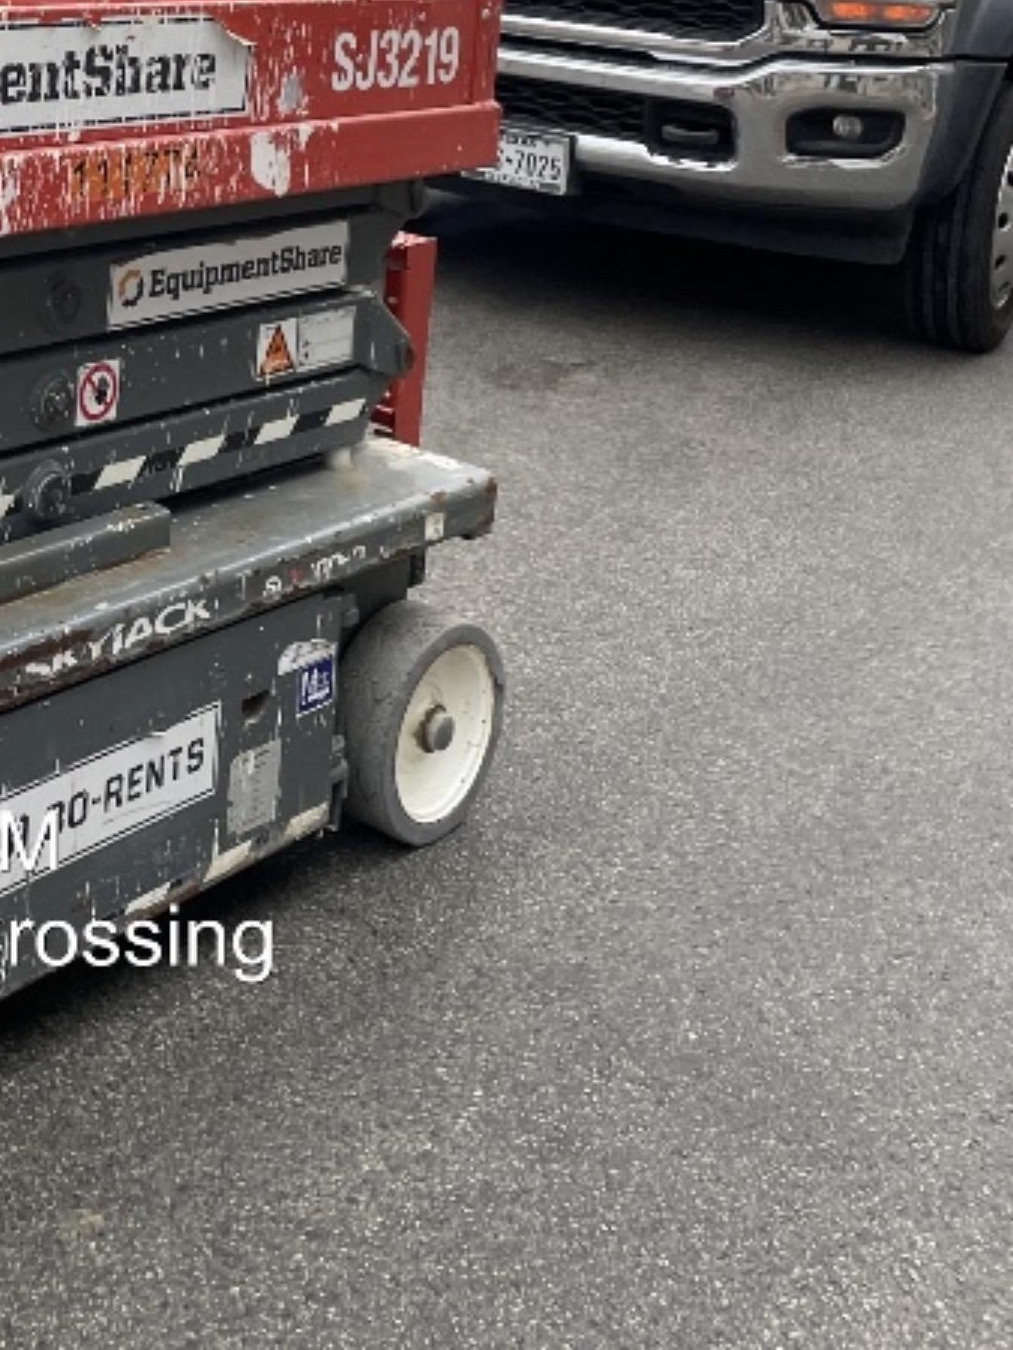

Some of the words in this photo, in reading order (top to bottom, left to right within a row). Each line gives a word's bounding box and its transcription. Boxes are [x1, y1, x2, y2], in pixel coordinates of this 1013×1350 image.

[331, 26, 461, 92] SJ3219
[498, 148, 562, 182] -7025
[148, 243, 343, 298] EquipmentShare
